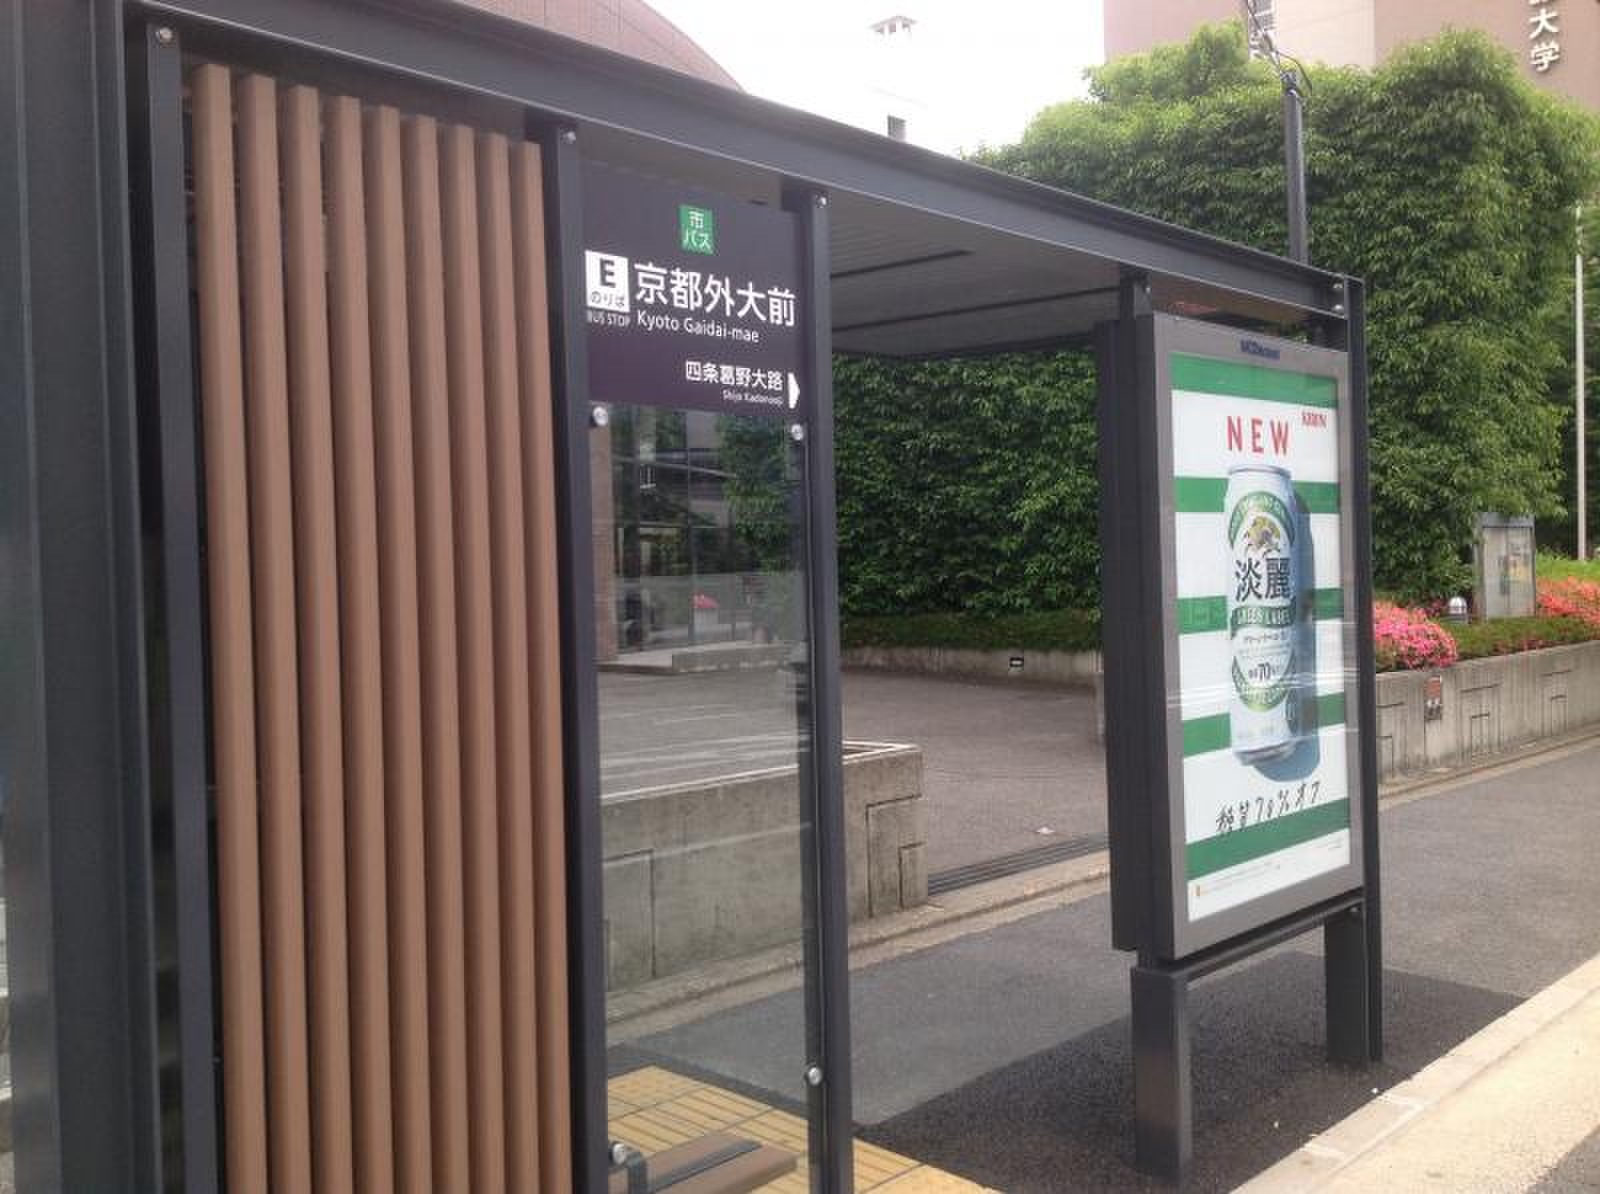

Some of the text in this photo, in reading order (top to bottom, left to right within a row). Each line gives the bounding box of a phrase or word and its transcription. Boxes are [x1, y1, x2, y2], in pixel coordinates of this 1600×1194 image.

[1529, 0, 1560, 72] 大学
[688, 209, 705, 230] 市
[682, 230, 713, 251] バス
[599, 257, 616, 289] E
[591, 290, 626, 308] のりば
[633, 262, 797, 327] 京都外大前
[607, 312, 630, 328] STOP
[637, 310, 760, 343] Kyoto Gaidai-mae
[685, 360, 783, 391] 四条葛野大路
[1227, 415, 1290, 456] NEW
[1234, 557, 1292, 602] 淡麗
